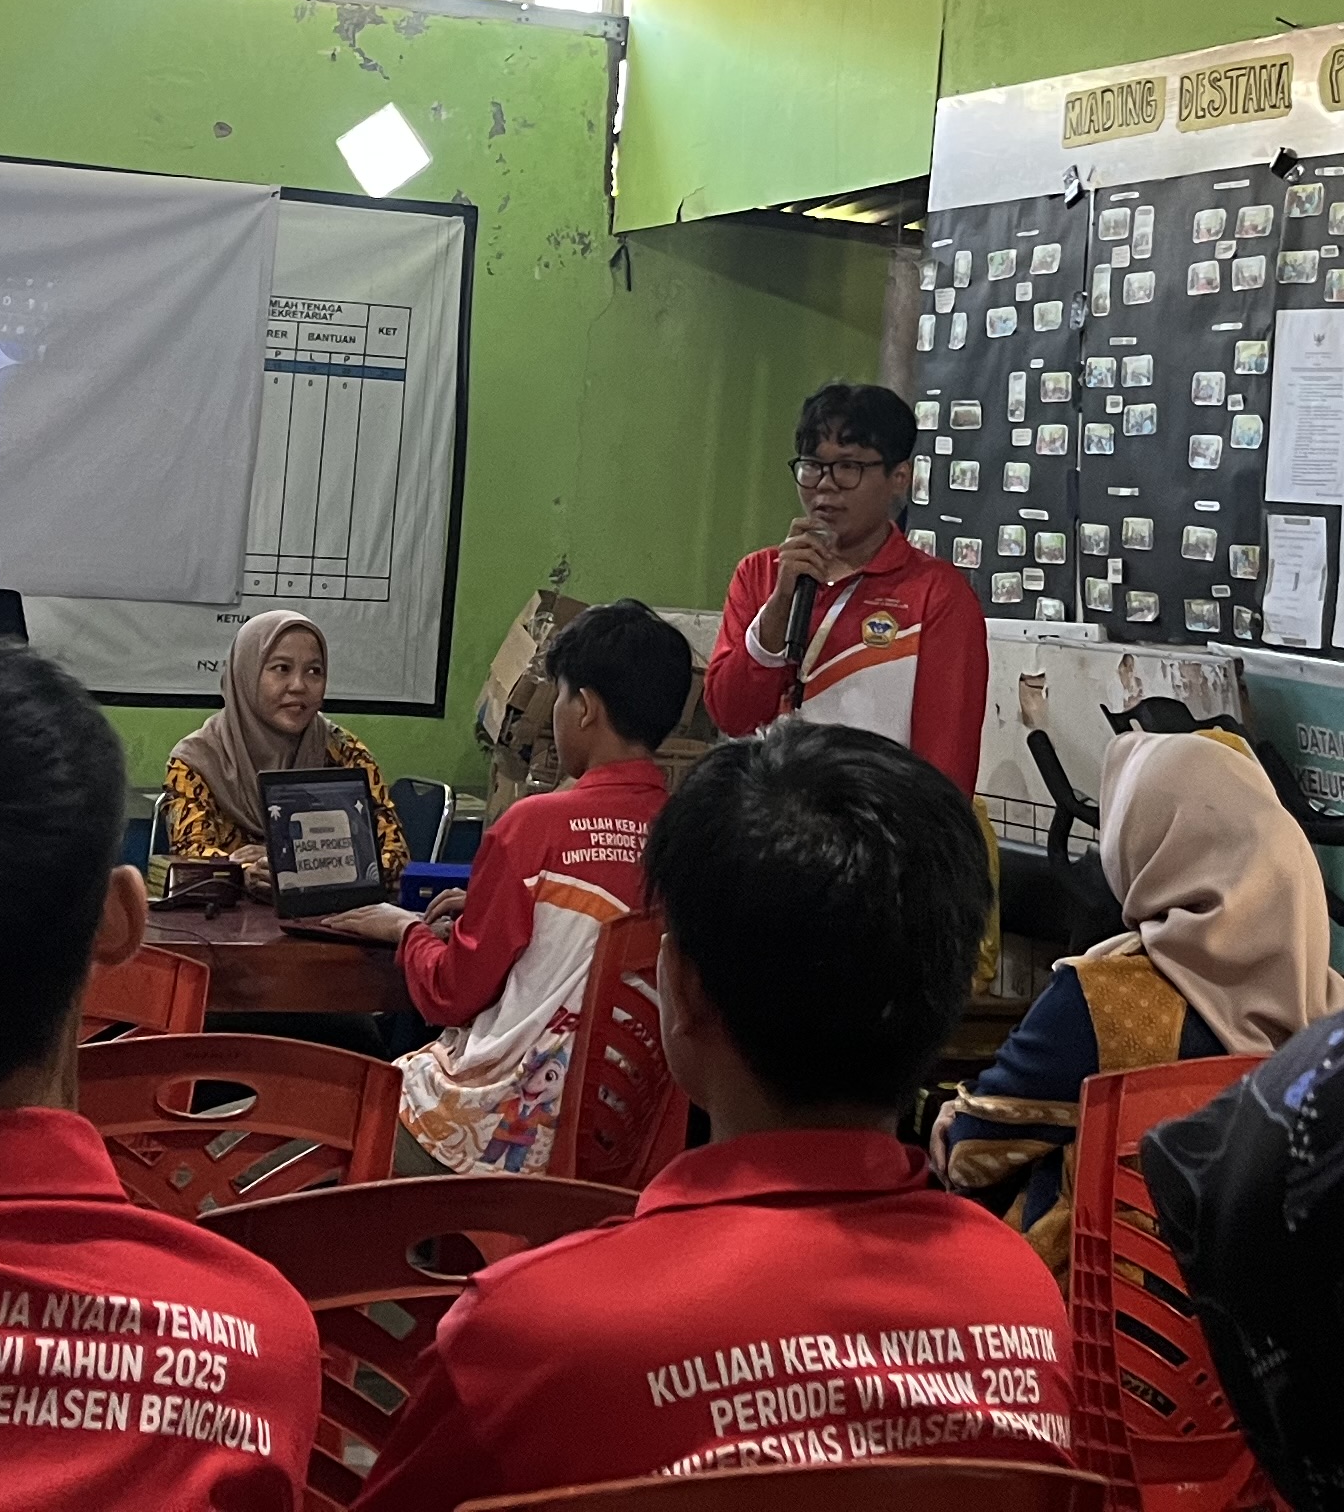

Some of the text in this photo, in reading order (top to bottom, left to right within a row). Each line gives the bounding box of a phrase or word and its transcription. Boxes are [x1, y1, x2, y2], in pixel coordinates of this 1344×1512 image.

[1064, 81, 1158, 140] MADING
[1179, 62, 1292, 121] DESTANA
[301, 302, 343, 314] TENAGA
[307, 332, 356, 344] BANTUAN
[378, 326, 398, 337] KET
[1297, 725, 1338, 757] DATA
[569, 817, 613, 831] KULIAH
[590, 832, 636, 848] PERIODE
[562, 848, 635, 865] UNIVERSITAS
[43, 1292, 142, 1334] NYATA
[153, 1299, 260, 1358] TEMATIK
[34, 1336, 144, 1384] TAHUN
[153, 1345, 228, 1395] 2025
[646, 1324, 1058, 1408] KULIAH KERJA NYATA TEMATIK
[139, 1393, 272, 1457] BENGKULU
[710, 1368, 1041, 1437] PERIODE VI TAHUN 2025
[849, 1410, 984, 1458] DEHASEN
